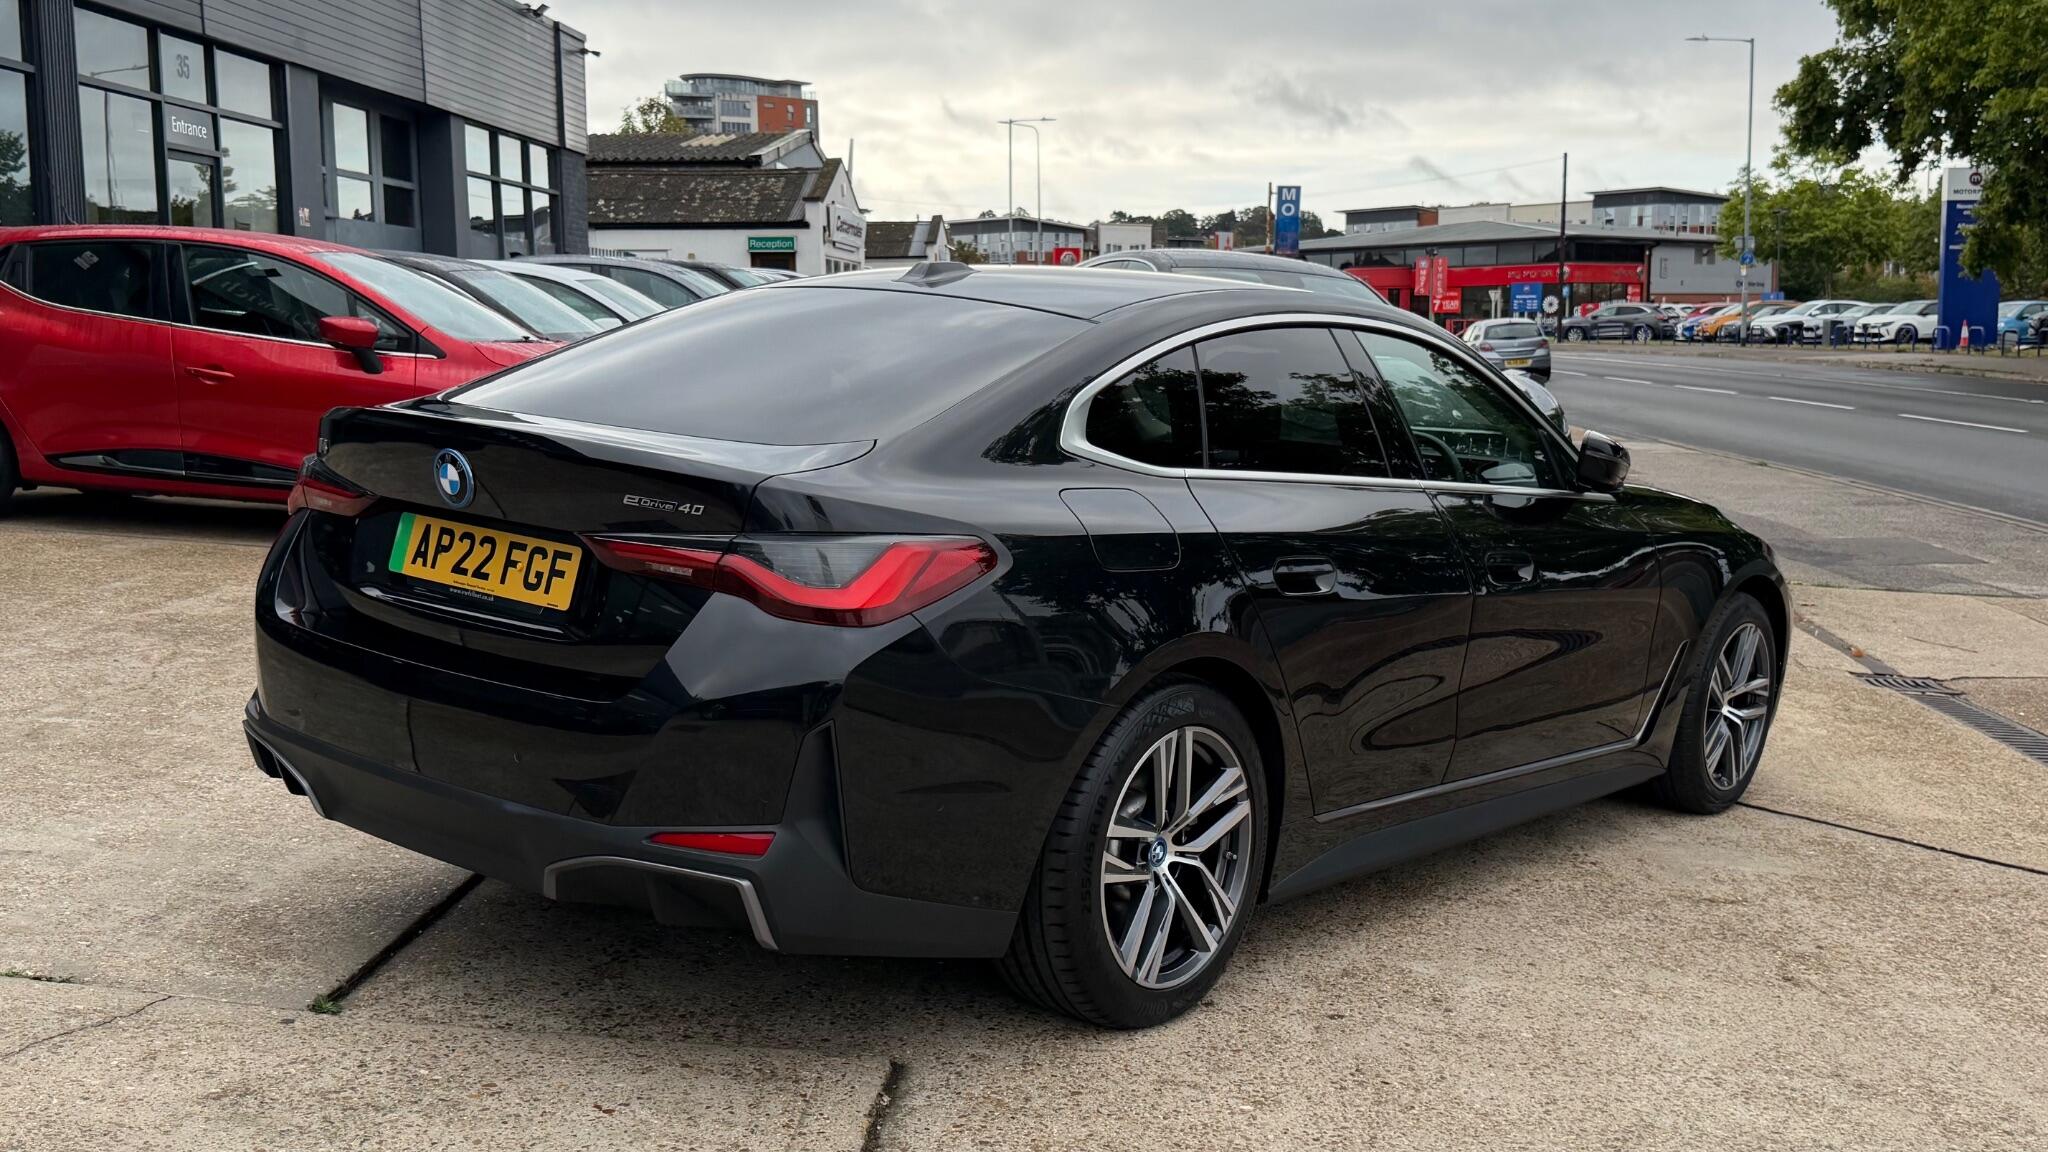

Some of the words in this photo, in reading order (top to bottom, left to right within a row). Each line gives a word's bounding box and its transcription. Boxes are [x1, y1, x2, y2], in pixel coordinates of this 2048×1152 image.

[176, 53, 190, 79] 35
[171, 115, 207, 139] Entrance
[749, 239, 793, 249] Reception
[678, 503, 705, 516] 40
[411, 523, 498, 582] AP22
[500, 540, 573, 596] FGF
